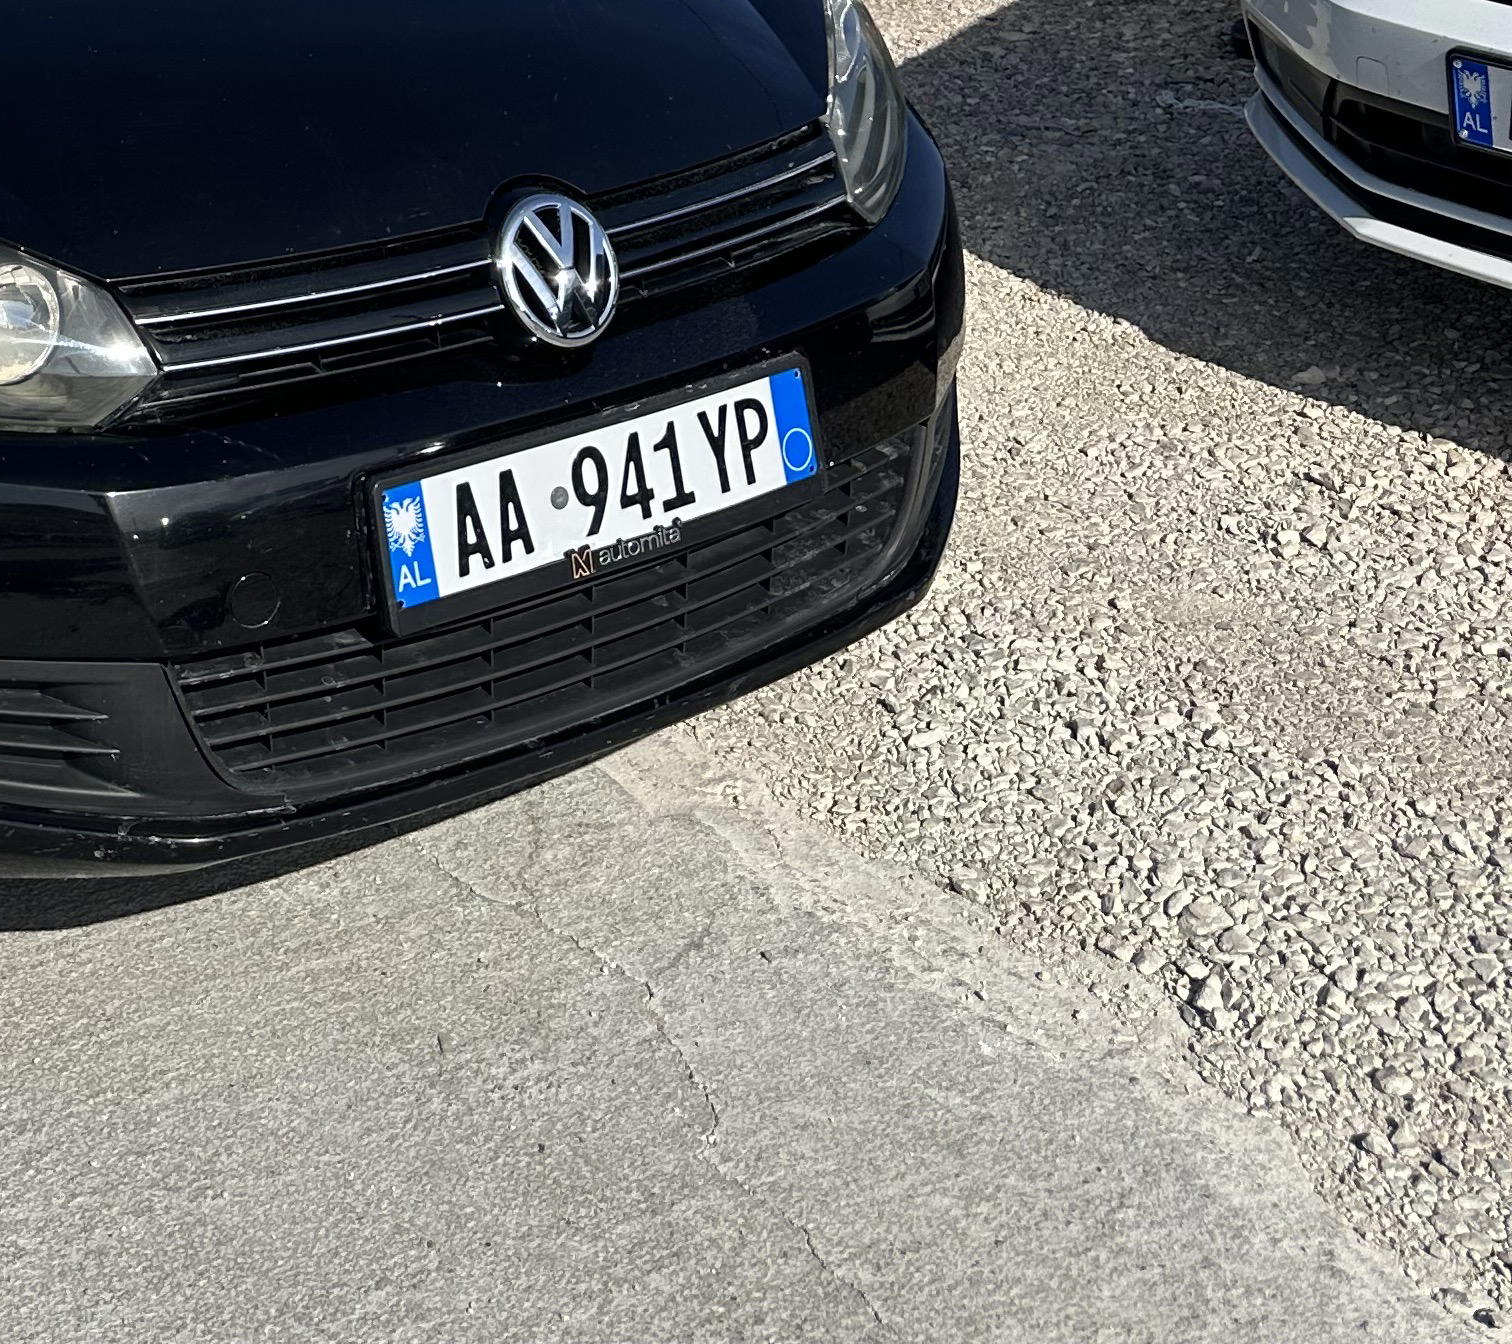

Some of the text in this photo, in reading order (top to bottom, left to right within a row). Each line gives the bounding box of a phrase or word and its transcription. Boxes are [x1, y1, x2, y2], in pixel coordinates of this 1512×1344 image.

[1463, 112, 1489, 133] AL
[456, 397, 769, 579] AA 941 YP
[398, 560, 432, 593] AL
